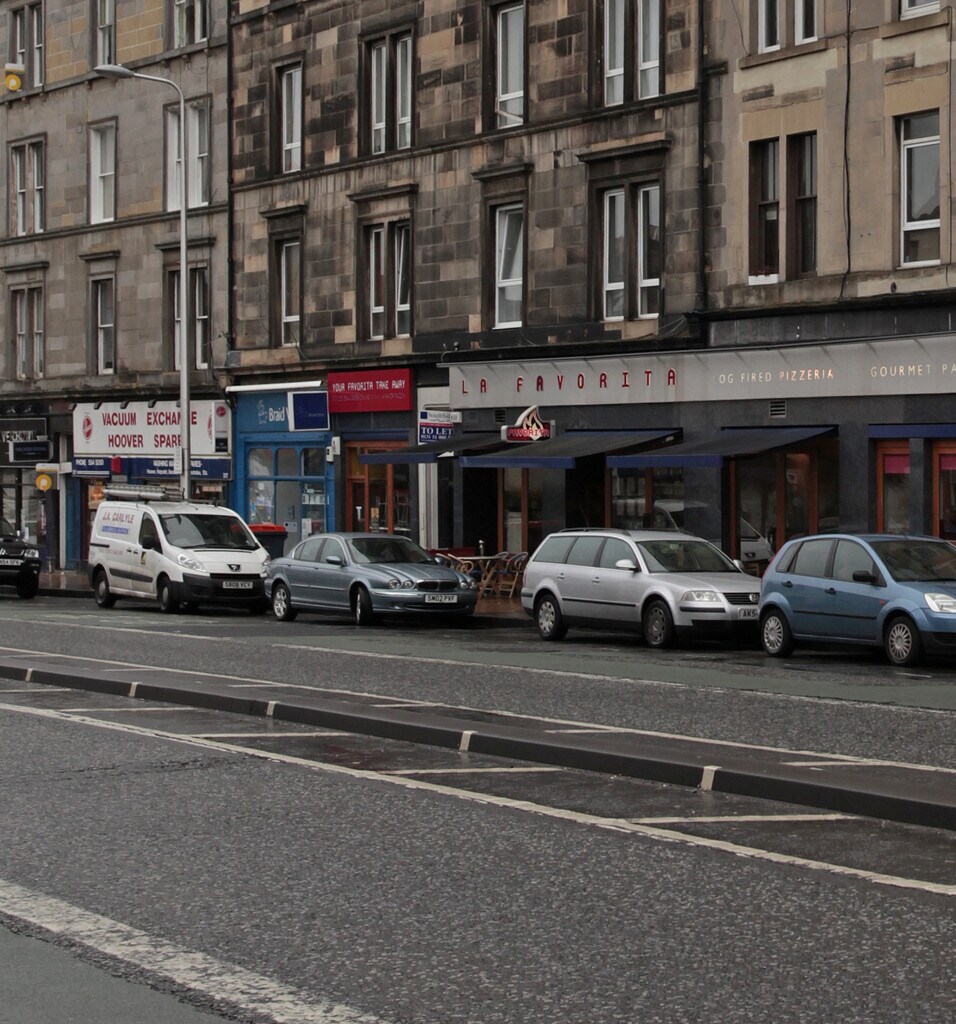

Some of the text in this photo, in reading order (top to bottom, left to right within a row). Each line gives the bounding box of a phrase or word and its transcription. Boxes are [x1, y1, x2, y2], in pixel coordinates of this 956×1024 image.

[740, 372, 772, 383] FIRED
[779, 369, 834, 381] PIZZERIA
[870, 364, 931, 378] GOURMET
[332, 379, 406, 392] YOUR FAVORITA TAKE AWAY
[462, 369, 676, 394] LA FAVORITA
[102, 411, 197, 426] VACUUM EXCHANE
[269, 407, 285, 422] Braid
[422, 427, 453, 436] TO LET
[108, 434, 144, 448] HOOVER
